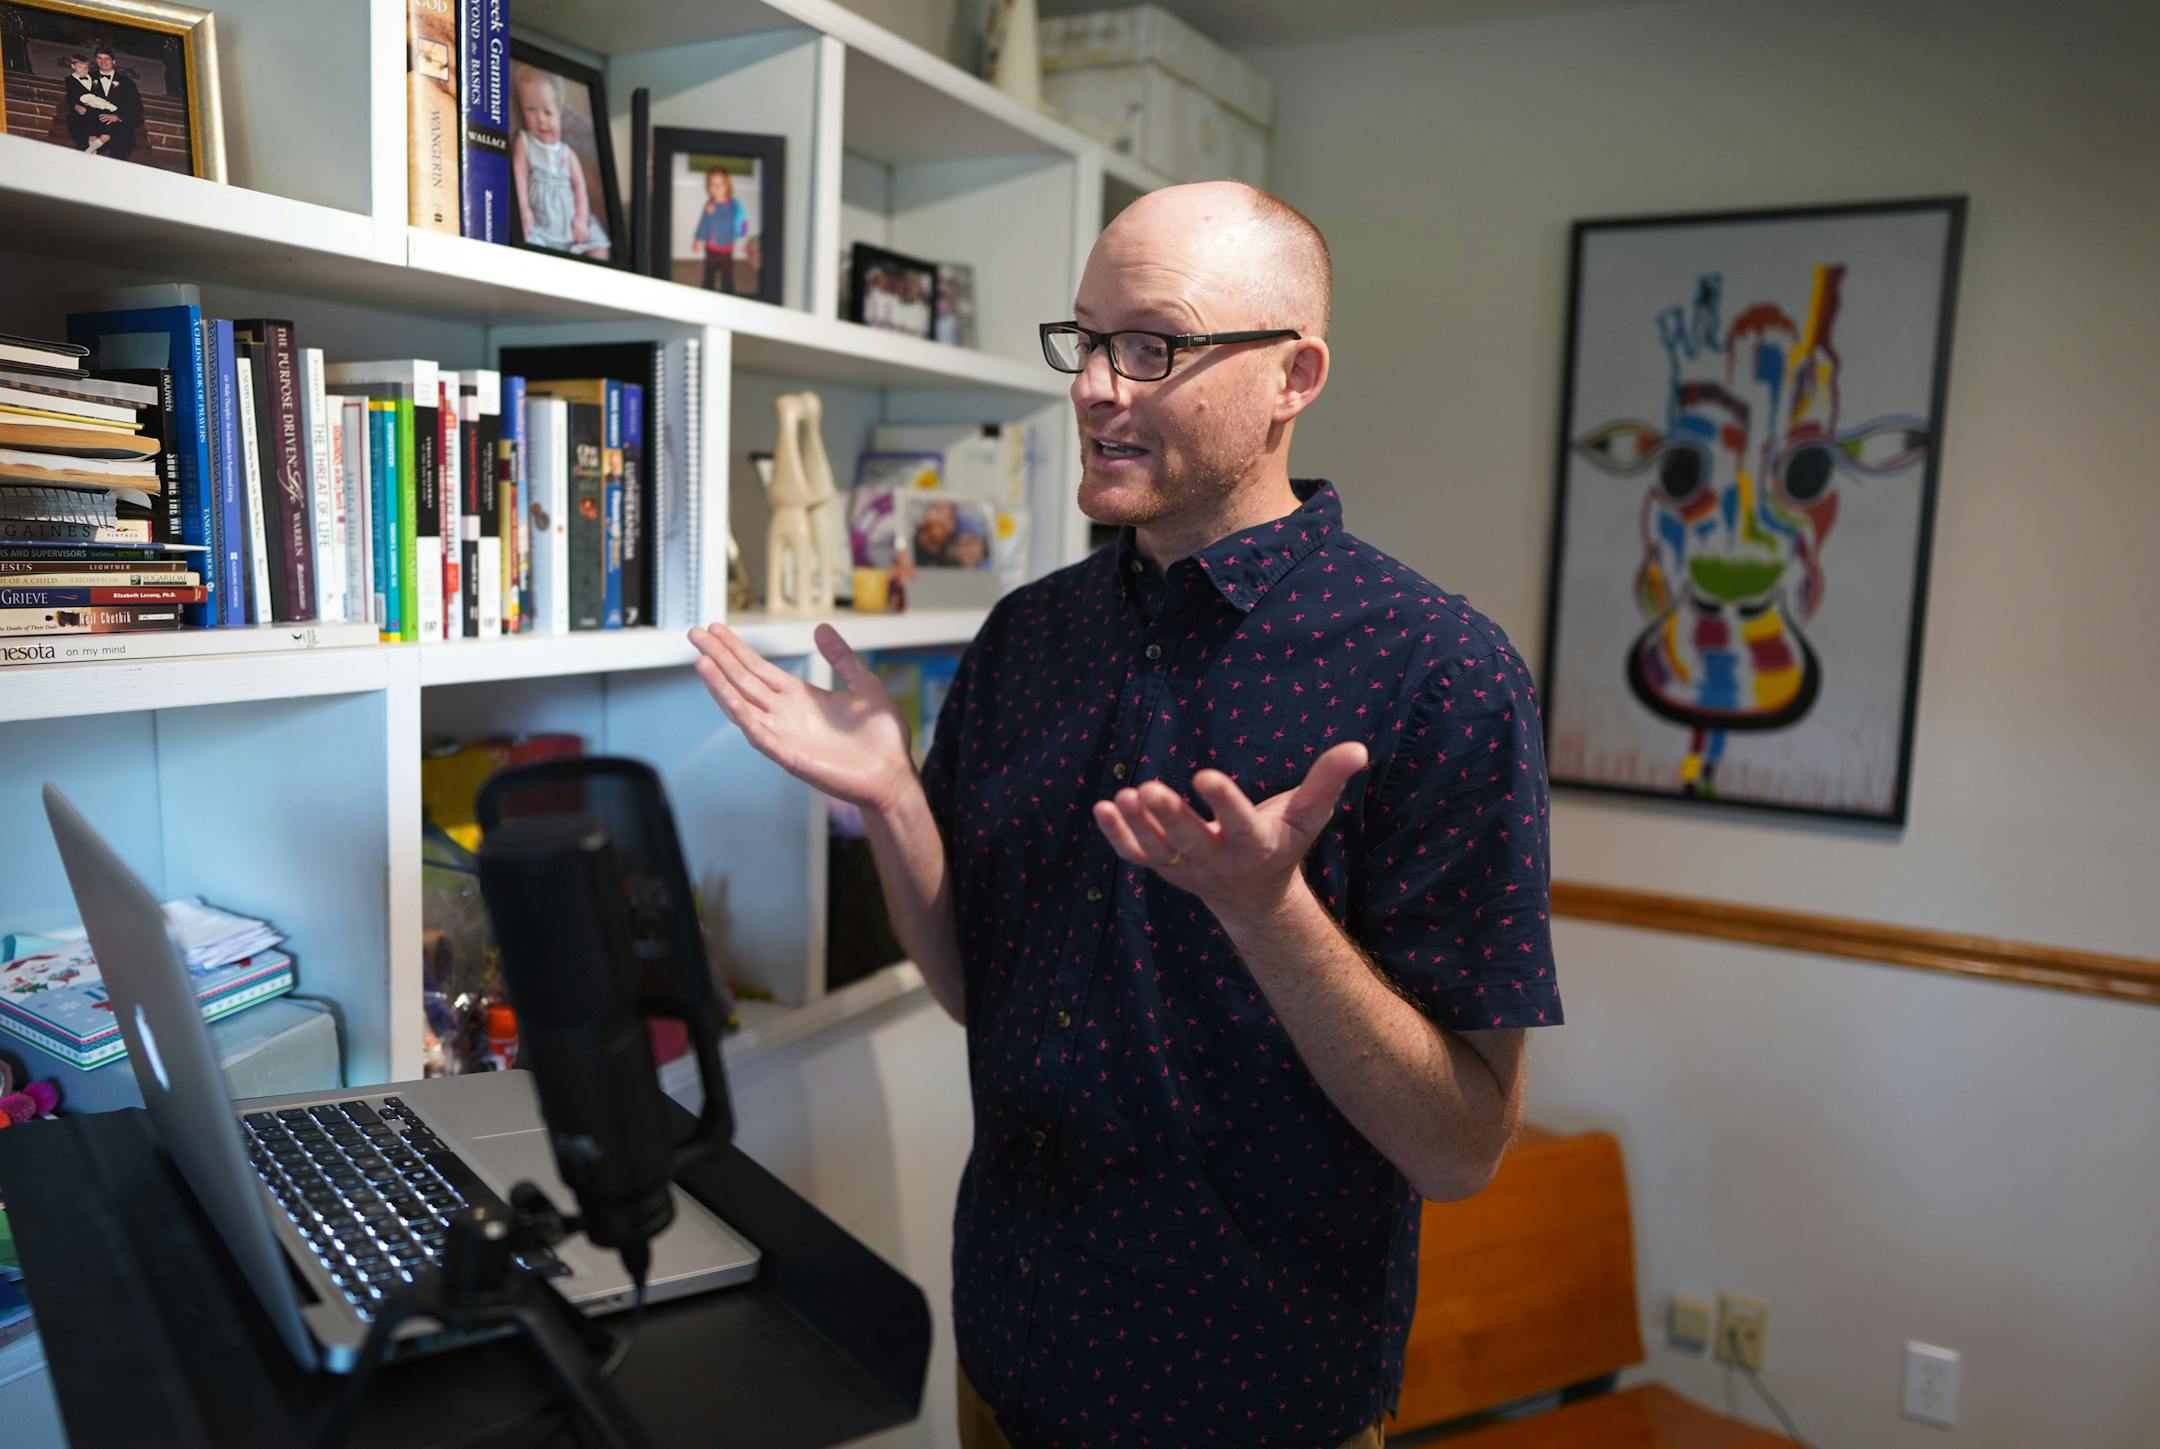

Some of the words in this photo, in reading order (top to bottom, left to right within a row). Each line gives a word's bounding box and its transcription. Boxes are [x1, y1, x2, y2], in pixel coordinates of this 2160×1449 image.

[471, 59, 480, 105] BASICS
[490, 38, 503, 125] Grammar
[431, 111, 443, 189] WANGERIN
[467, 131, 507, 150] WALLACE
[277, 328, 288, 348] THE
[278, 352, 293, 410] PURPOSE
[163, 374, 173, 412] NOUWEN
[313, 423, 325, 446] THE
[166, 453, 178, 480] SHOW
[315, 452, 327, 496] THREAT
[167, 481, 179, 496] ME
[168, 499, 180, 515] THE
[317, 501, 328, 515] OF
[5, 523, 91, 538] GAINES
[170, 517, 182, 536] WAY
[292, 511, 304, 557] WARREN
[318, 521, 330, 547] LIFE
[10, 549, 30, 558] AND
[31, 549, 87, 558] SUPERVISORS
[70, 576, 119, 584] THOMPSON
[1, 588, 49, 605] GRIEVE
[79, 612, 97, 625] Neil
[100, 611, 132, 624] Chethik
[66, 649, 79, 657] on
[83, 648, 98, 660] my
[102, 645, 126, 656] mind
